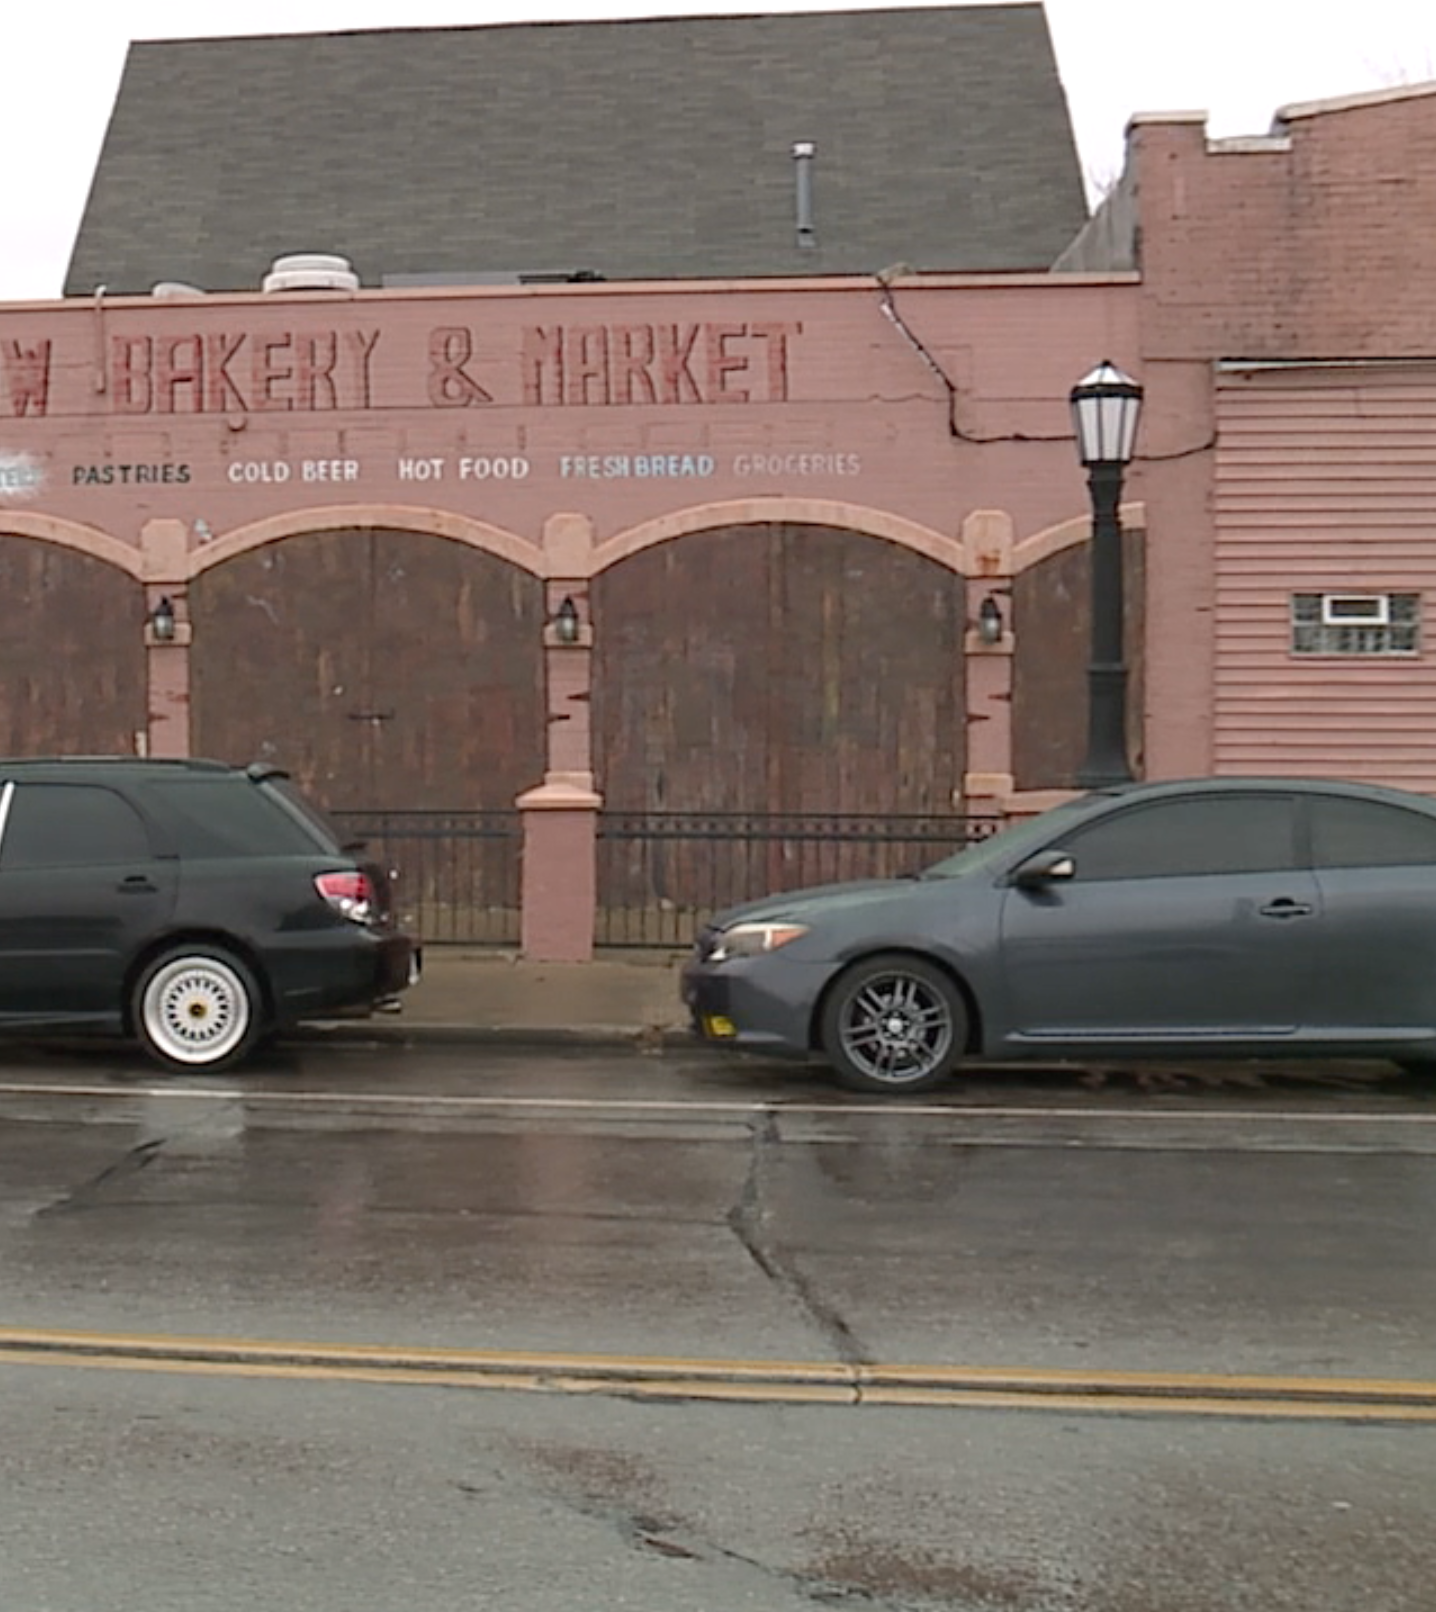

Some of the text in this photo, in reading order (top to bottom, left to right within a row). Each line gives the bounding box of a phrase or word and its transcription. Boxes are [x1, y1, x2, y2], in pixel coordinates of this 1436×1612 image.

[111, 329, 381, 415] BAKERY
[427, 326, 494, 408] &
[521, 322, 802, 405] MARKET
[72, 464, 192, 485] PASTRIES
[228, 459, 360, 482] COLD BEER
[398, 456, 530, 480] HOT FOOD
[560, 454, 715, 478] FRESH BREAD
[732, 454, 861, 476] GROCERIES
